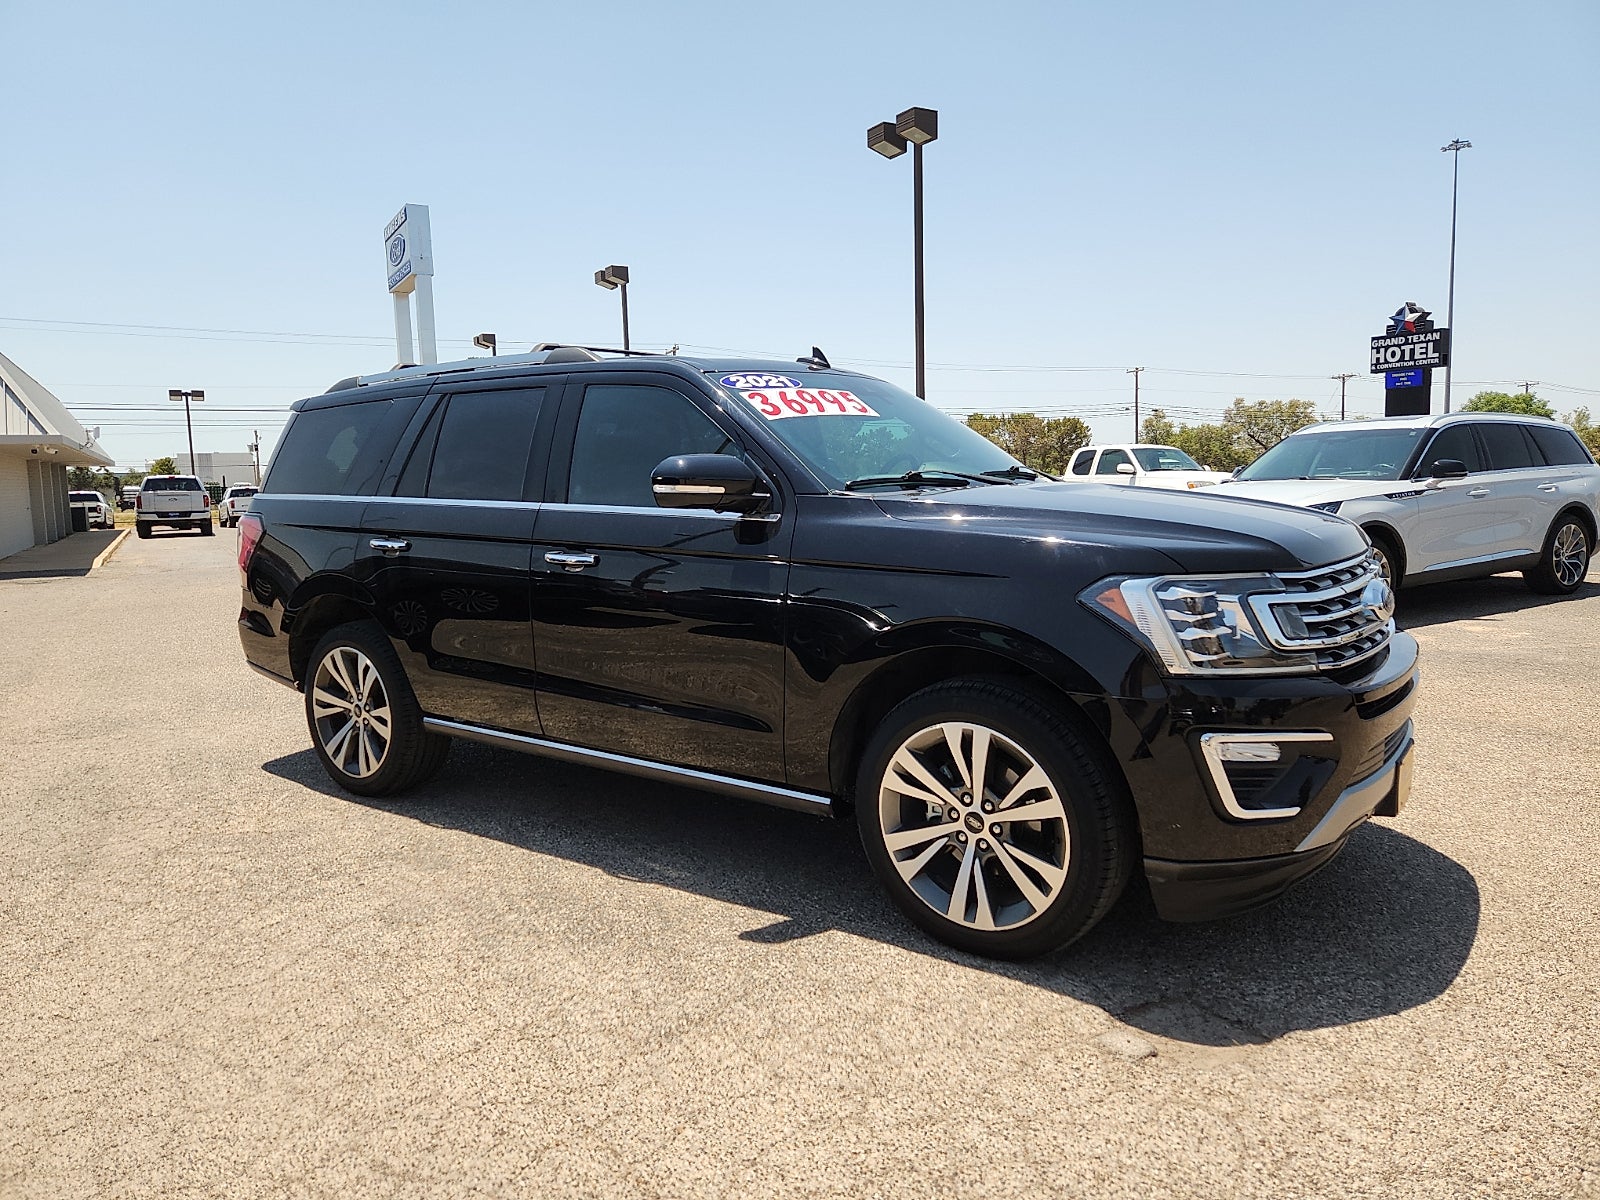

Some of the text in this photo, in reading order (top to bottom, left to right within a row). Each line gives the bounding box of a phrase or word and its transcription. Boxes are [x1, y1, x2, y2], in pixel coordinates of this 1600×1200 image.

[1371, 332, 1440, 347] GRAND TEXAN
[1371, 342, 1439, 364] HOTEL
[1377, 361, 1414, 370] CONVENTION
[729, 375, 795, 388] 2021
[748, 389, 868, 416] 36995
